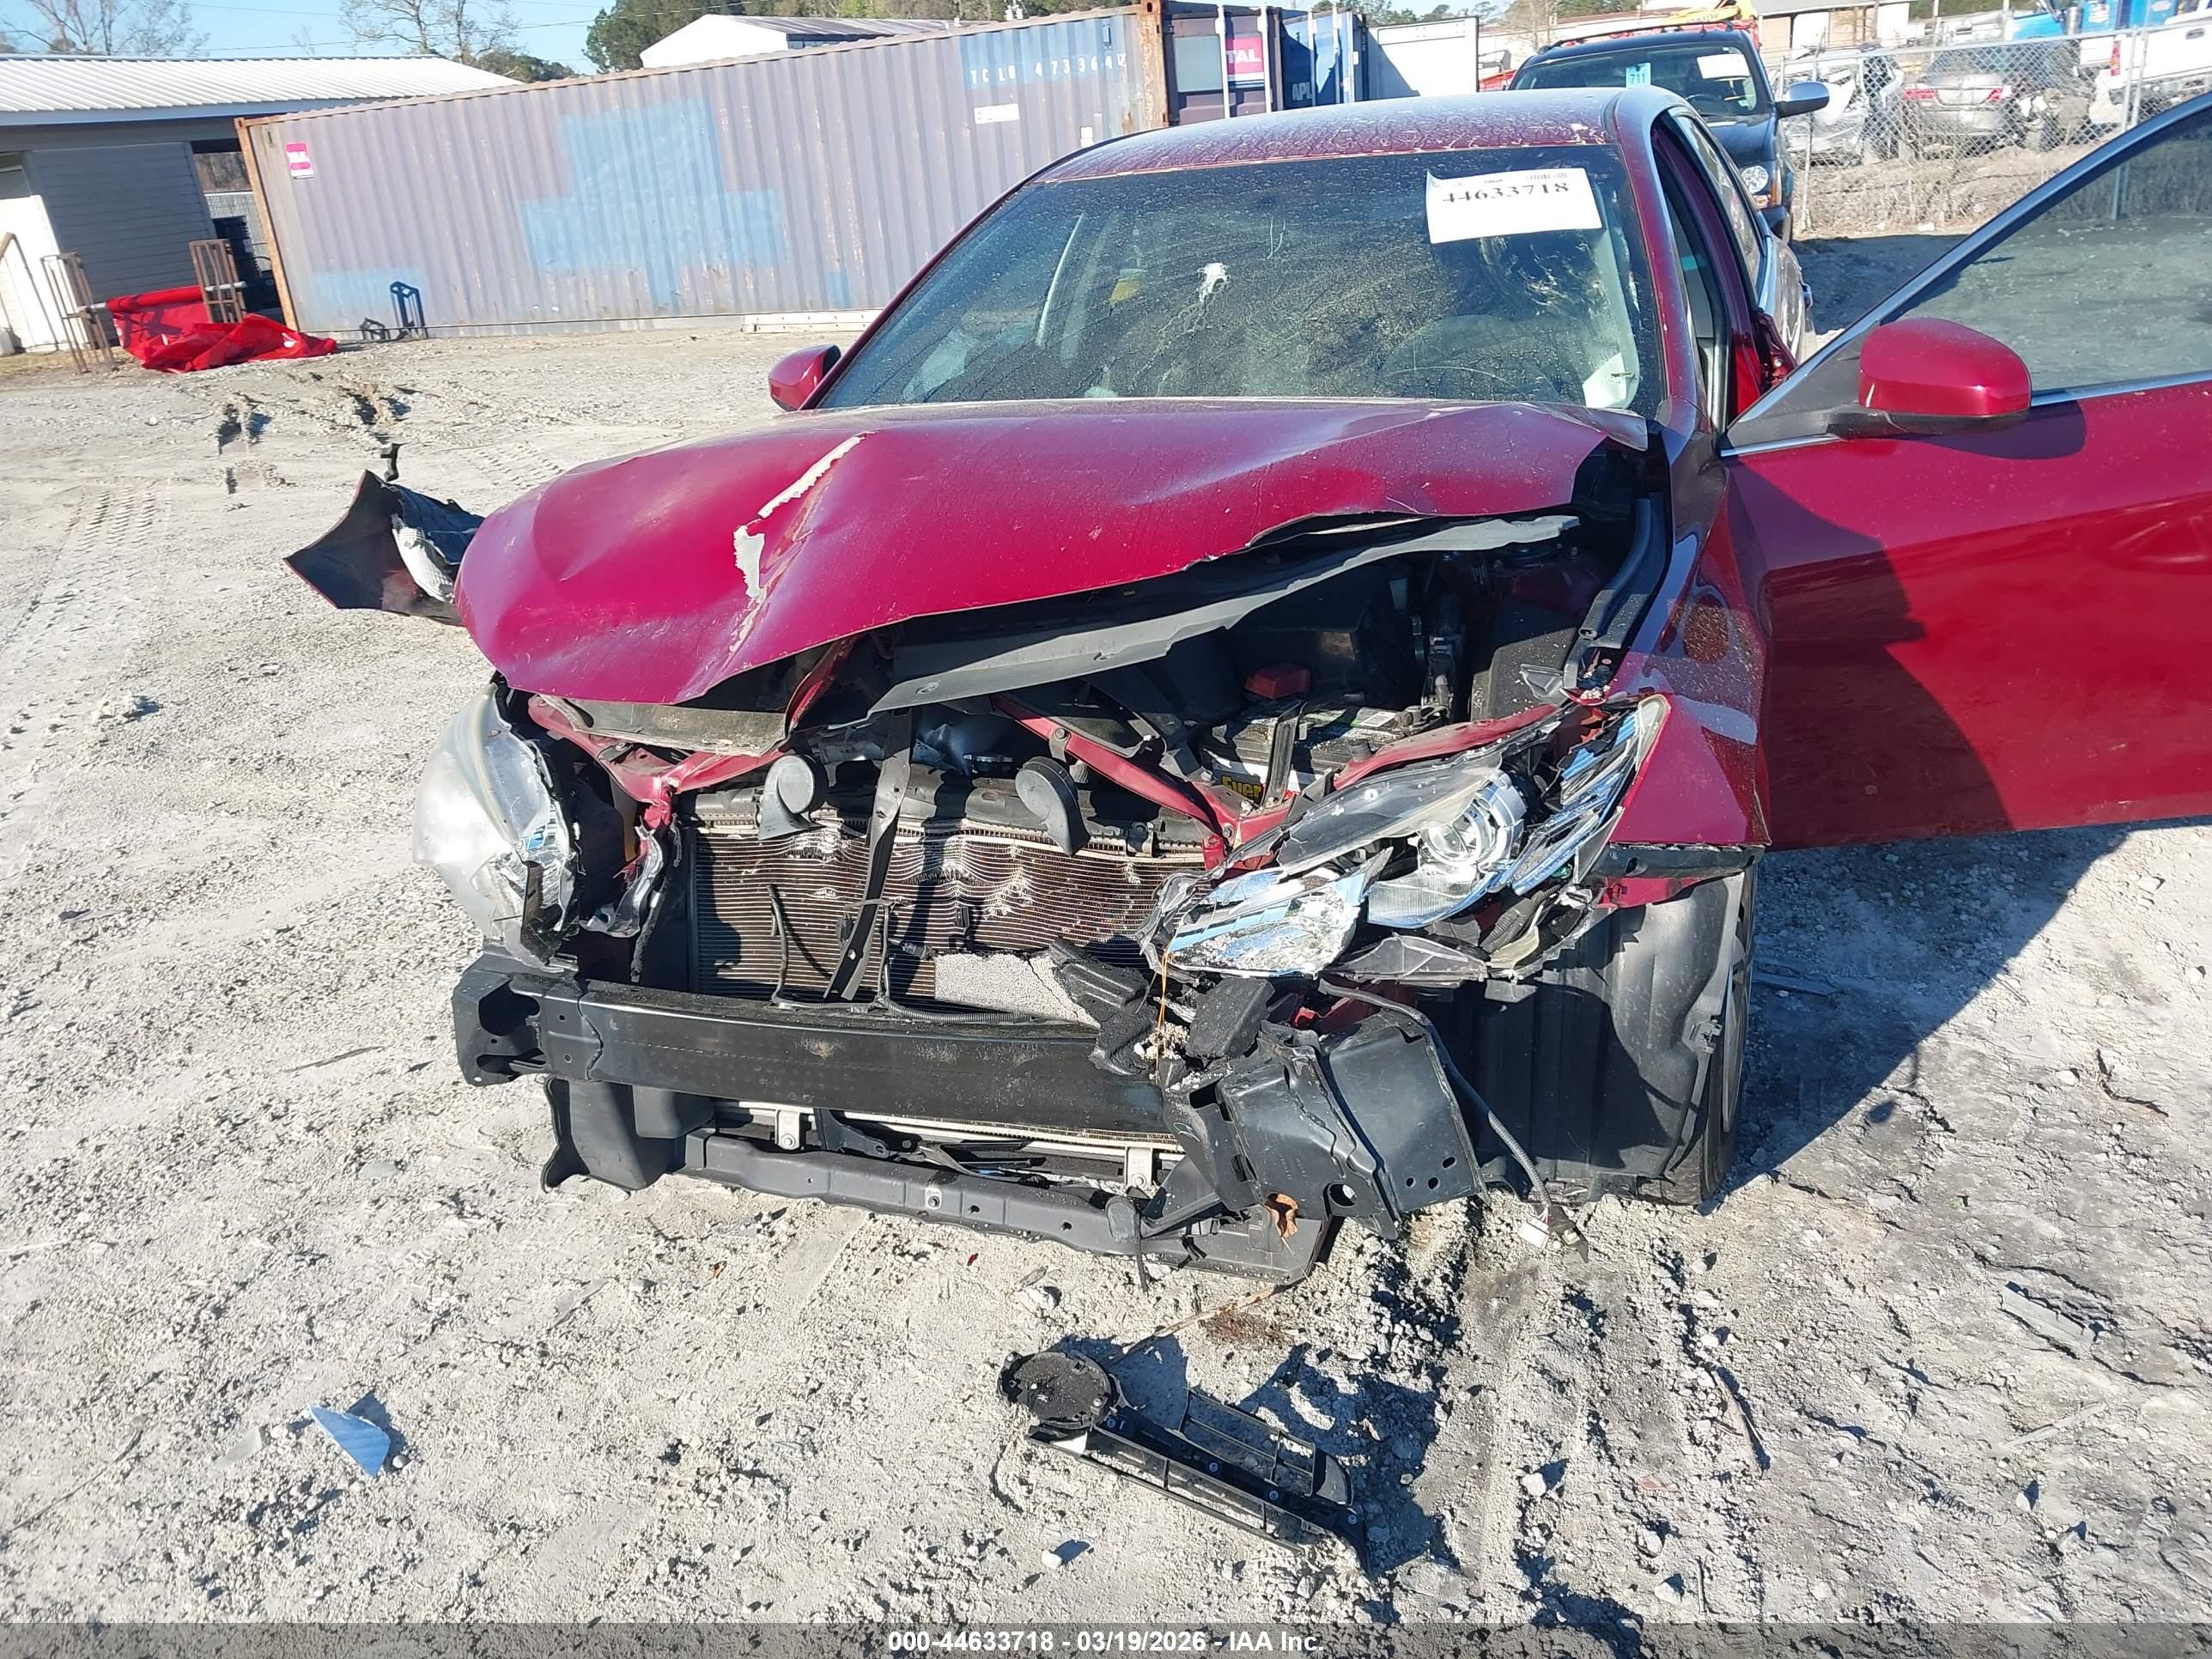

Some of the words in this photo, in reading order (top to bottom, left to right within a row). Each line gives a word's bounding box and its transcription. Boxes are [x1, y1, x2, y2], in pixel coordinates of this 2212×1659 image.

[1629, 73, 1645, 84] 711
[1291, 82, 1313, 101] APL
[1443, 182, 1570, 203] 44633718
